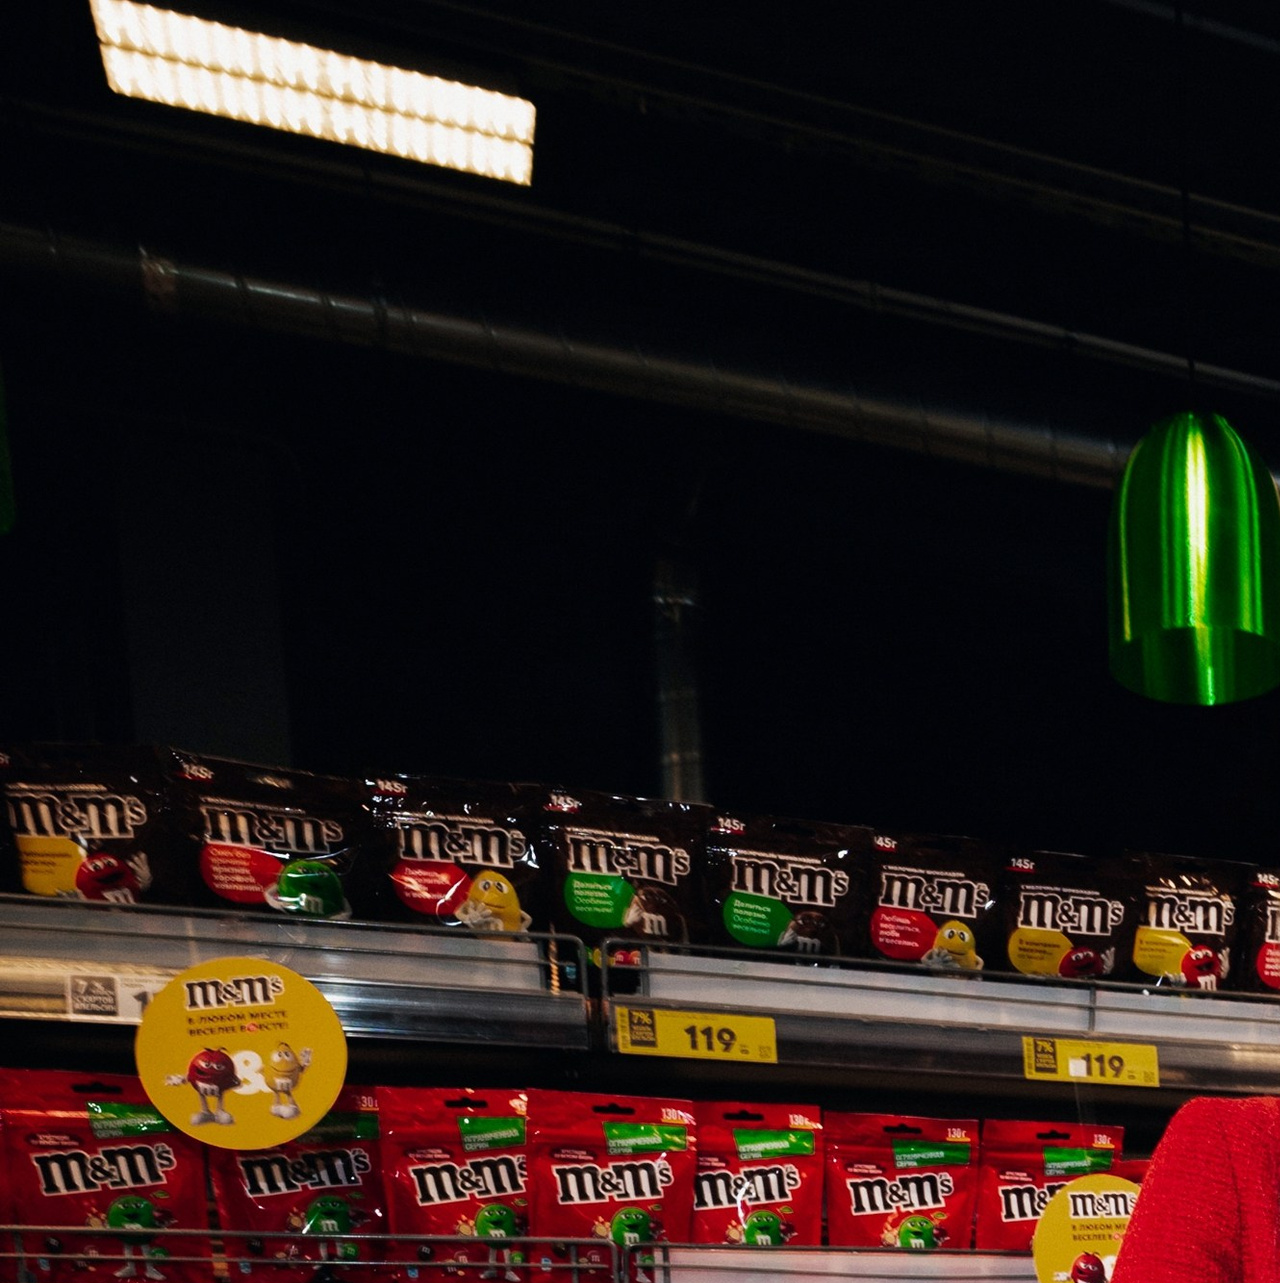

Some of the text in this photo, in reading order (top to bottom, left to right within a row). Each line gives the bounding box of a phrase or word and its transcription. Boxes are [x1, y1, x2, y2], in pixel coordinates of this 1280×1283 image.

[184, 975, 285, 1011] m&m's
[684, 1025, 738, 1053] 119
[1081, 1054, 1125, 1079] 119
[30, 1143, 176, 1196] m&m's
[237, 1148, 371, 1196] m&m's
[551, 1160, 674, 1205] m&m's
[694, 1164, 801, 1210] m&m's
[847, 1172, 954, 1216] m&m's
